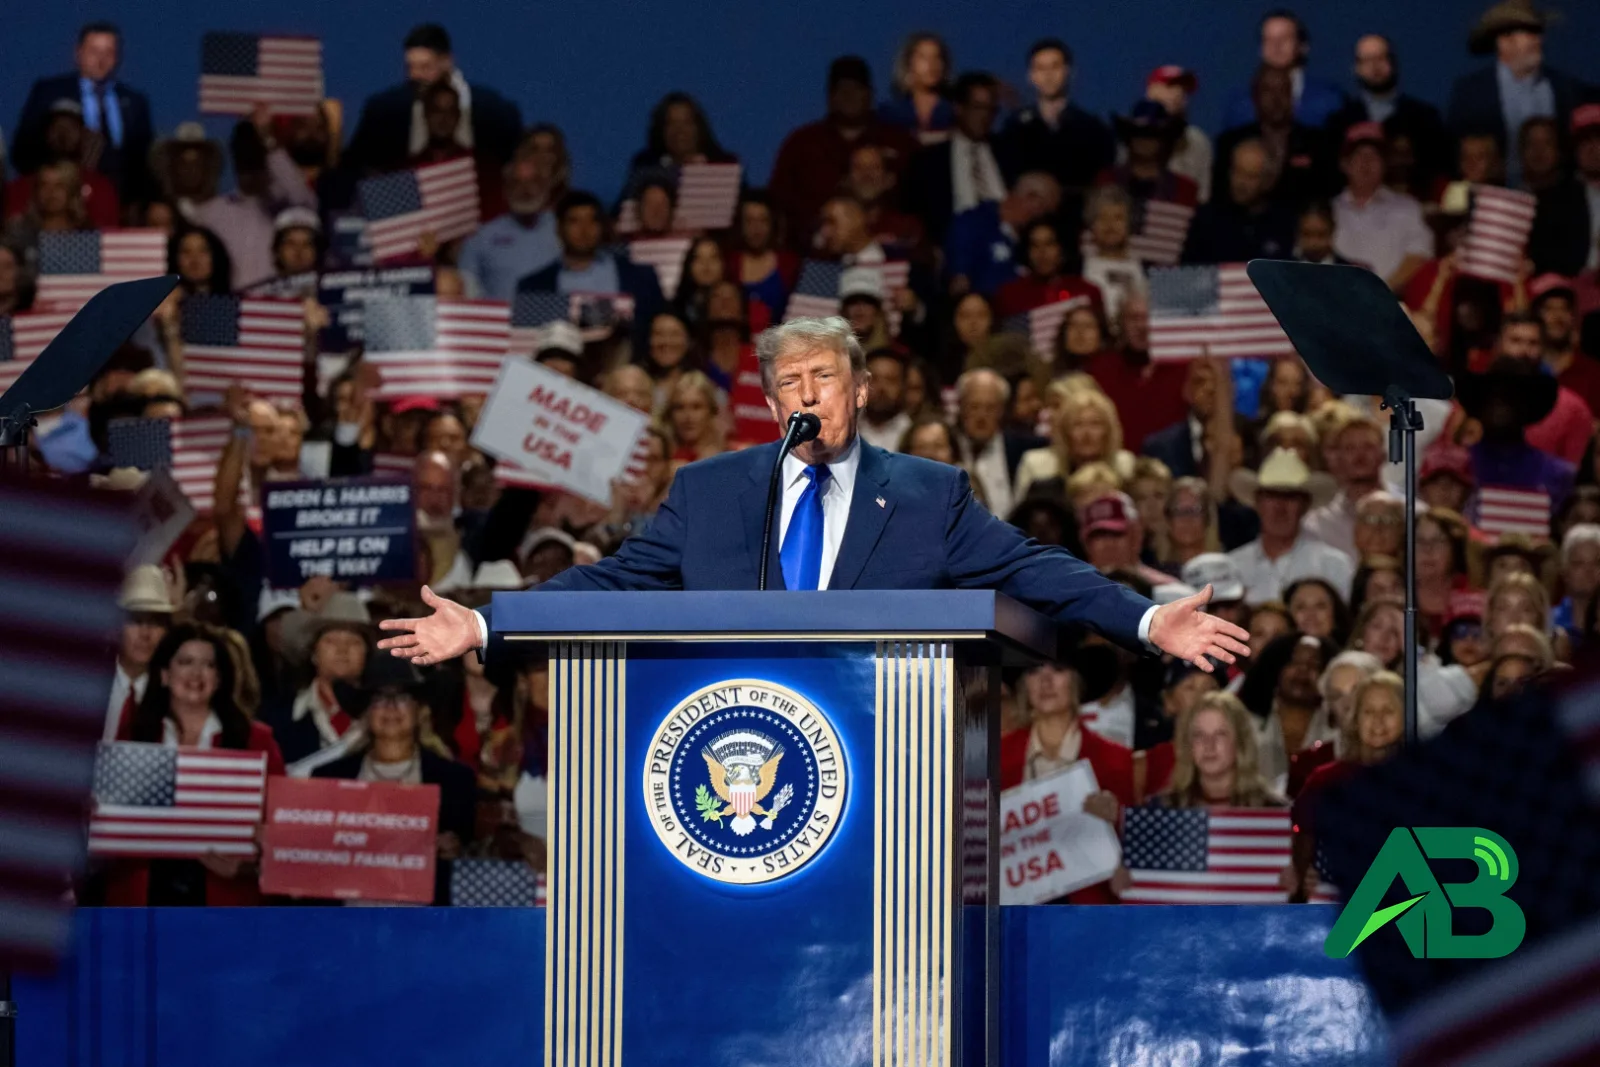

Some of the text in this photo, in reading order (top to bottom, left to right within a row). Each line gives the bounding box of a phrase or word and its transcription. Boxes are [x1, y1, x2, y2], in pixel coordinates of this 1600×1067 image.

[528, 384, 609, 434] MADE
[533, 414, 581, 445] IN THE
[522, 432, 573, 471] USA
[268, 486, 410, 509] BIDEN & HARRIS
[296, 507, 381, 528] BROKE IT
[289, 536, 390, 558] HELP IS ON
[299, 557, 382, 577] THE WAY
[651, 687, 838, 874] SEAL OF THE PRESIDENT OF THE UNITED STATES
[273, 808, 430, 831] BIGGER PAYCHECKS
[334, 831, 368, 847] FOR
[1020, 827, 1052, 850] THE
[273, 848, 426, 869] WORKING FAMILIES
[1005, 849, 1066, 888] USA
